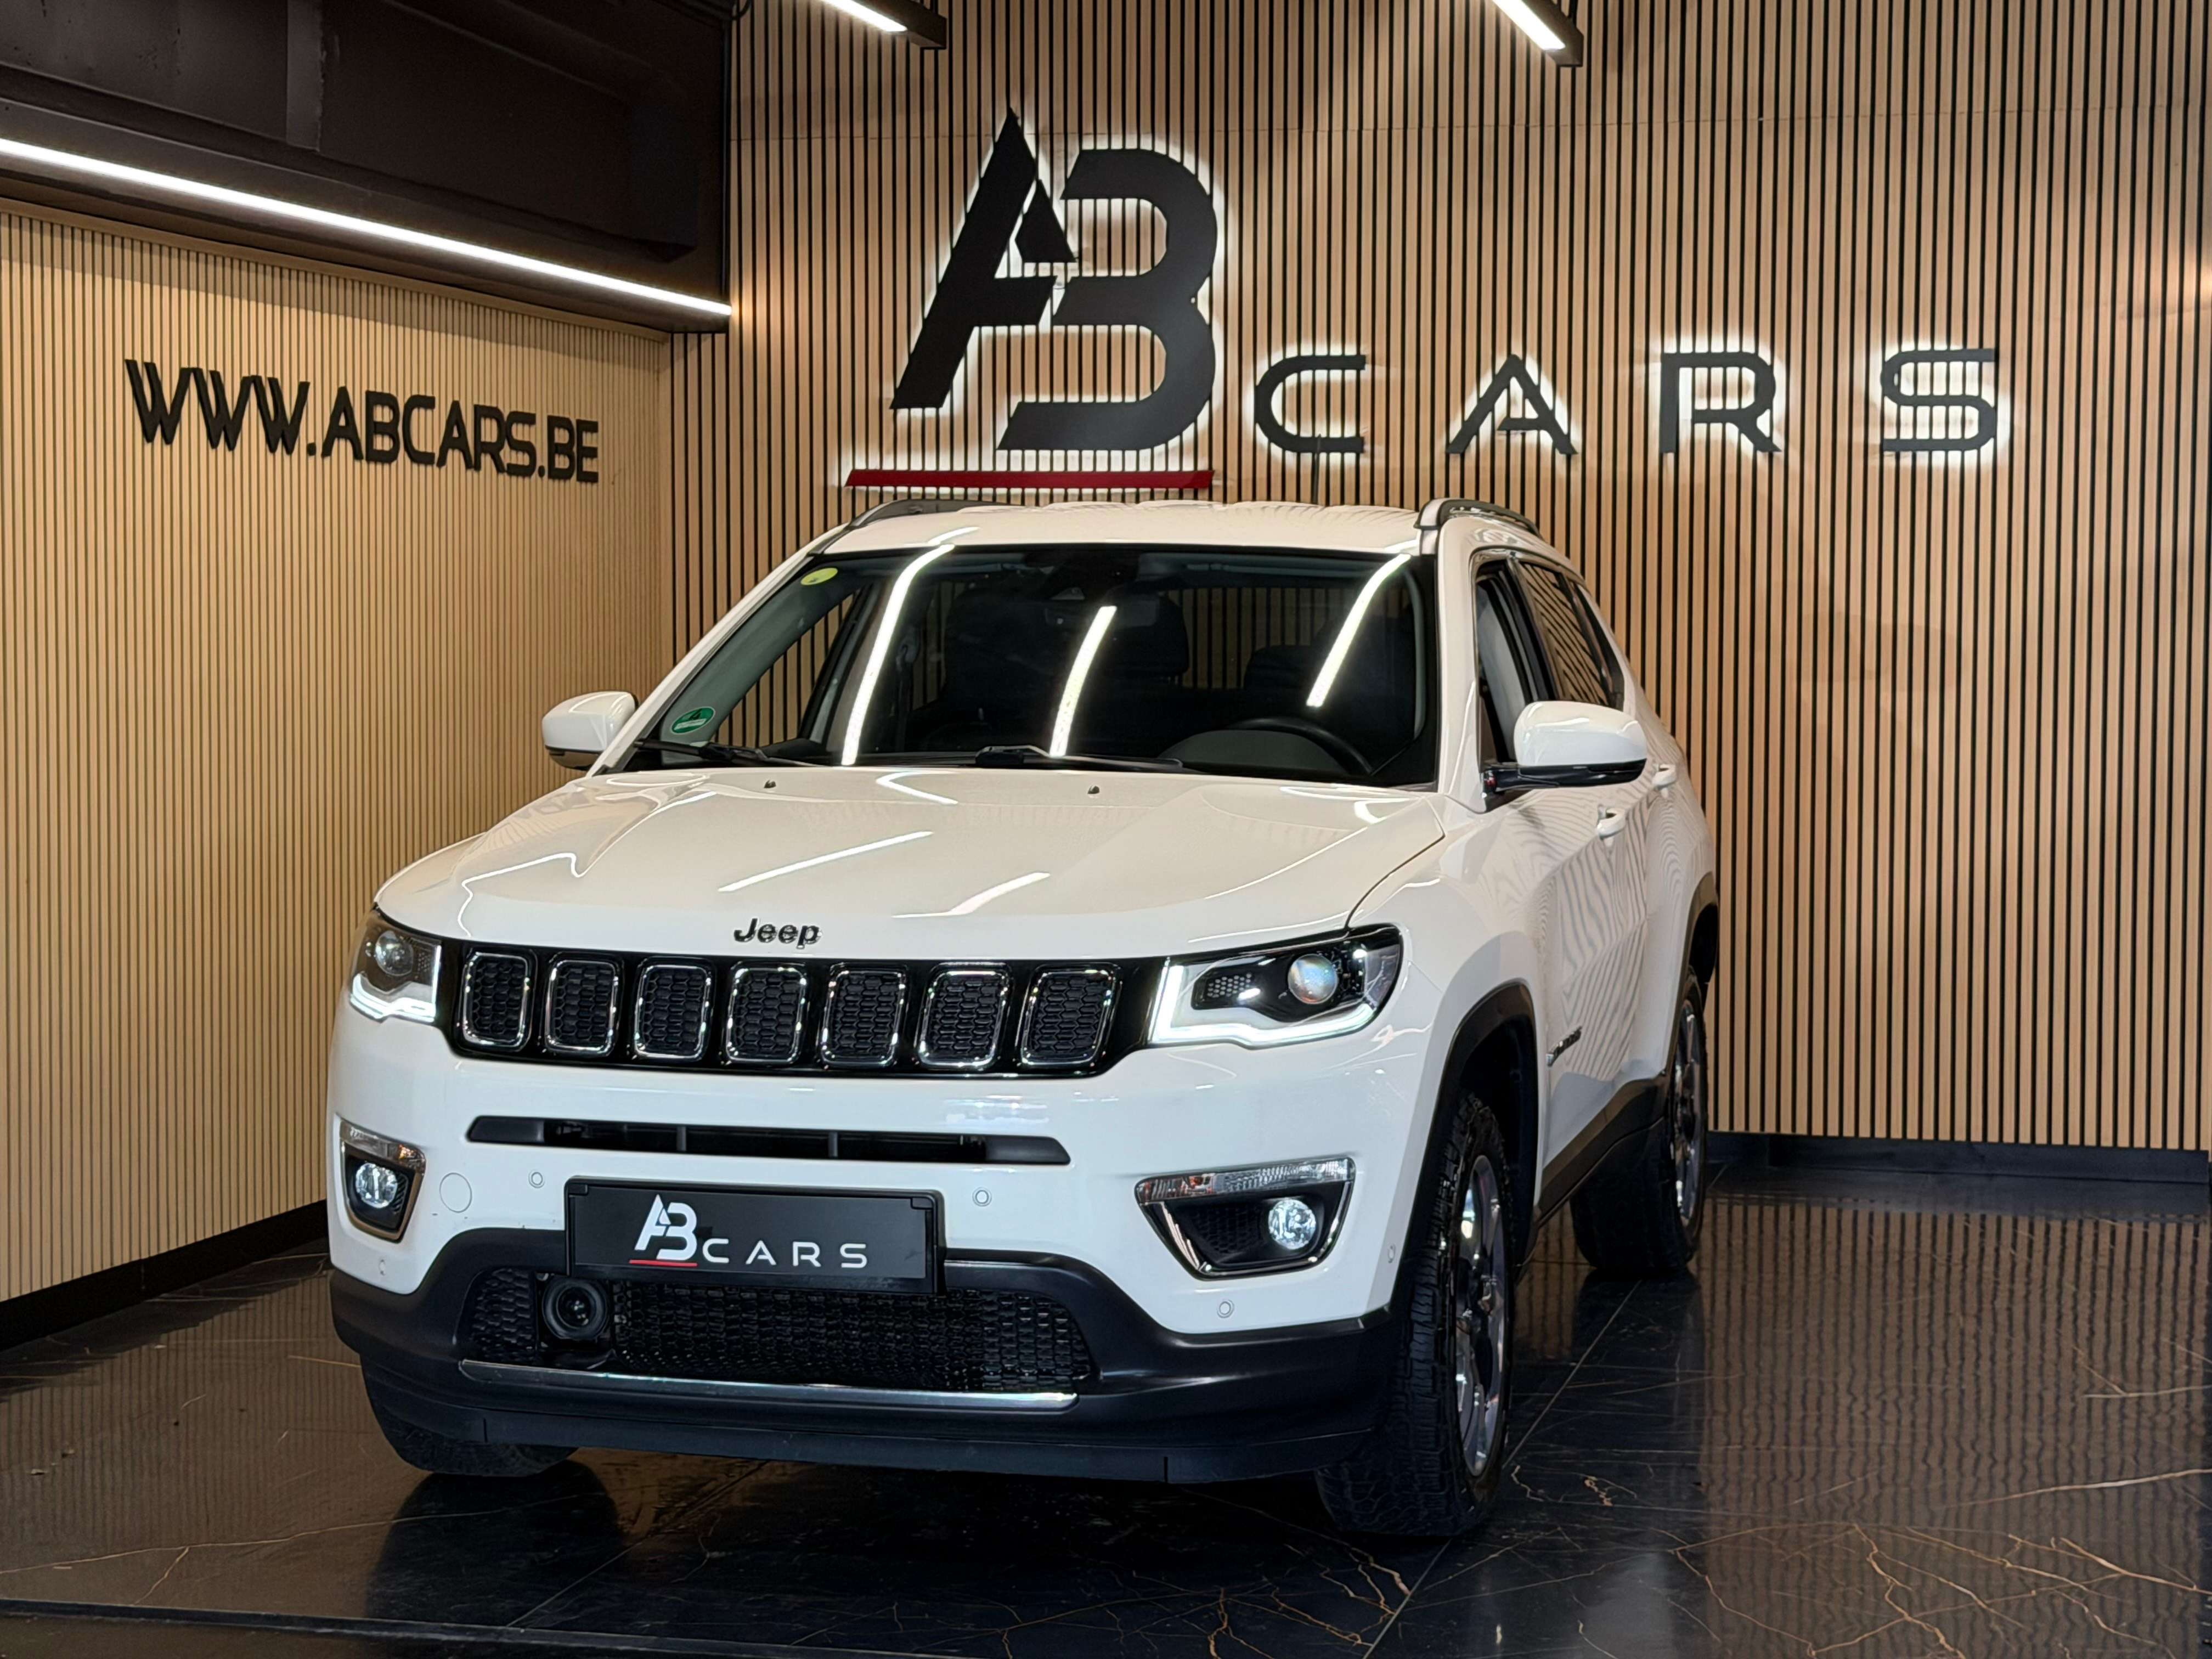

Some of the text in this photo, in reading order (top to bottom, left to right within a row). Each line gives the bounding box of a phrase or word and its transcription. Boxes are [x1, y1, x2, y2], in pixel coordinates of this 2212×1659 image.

[890, 108, 1997, 454] AB CARS
[125, 359, 599, 483] WWW.ABCARS.BE
[733, 918, 821, 949] Jeep
[634, 1194, 867, 1269] AB CARS
